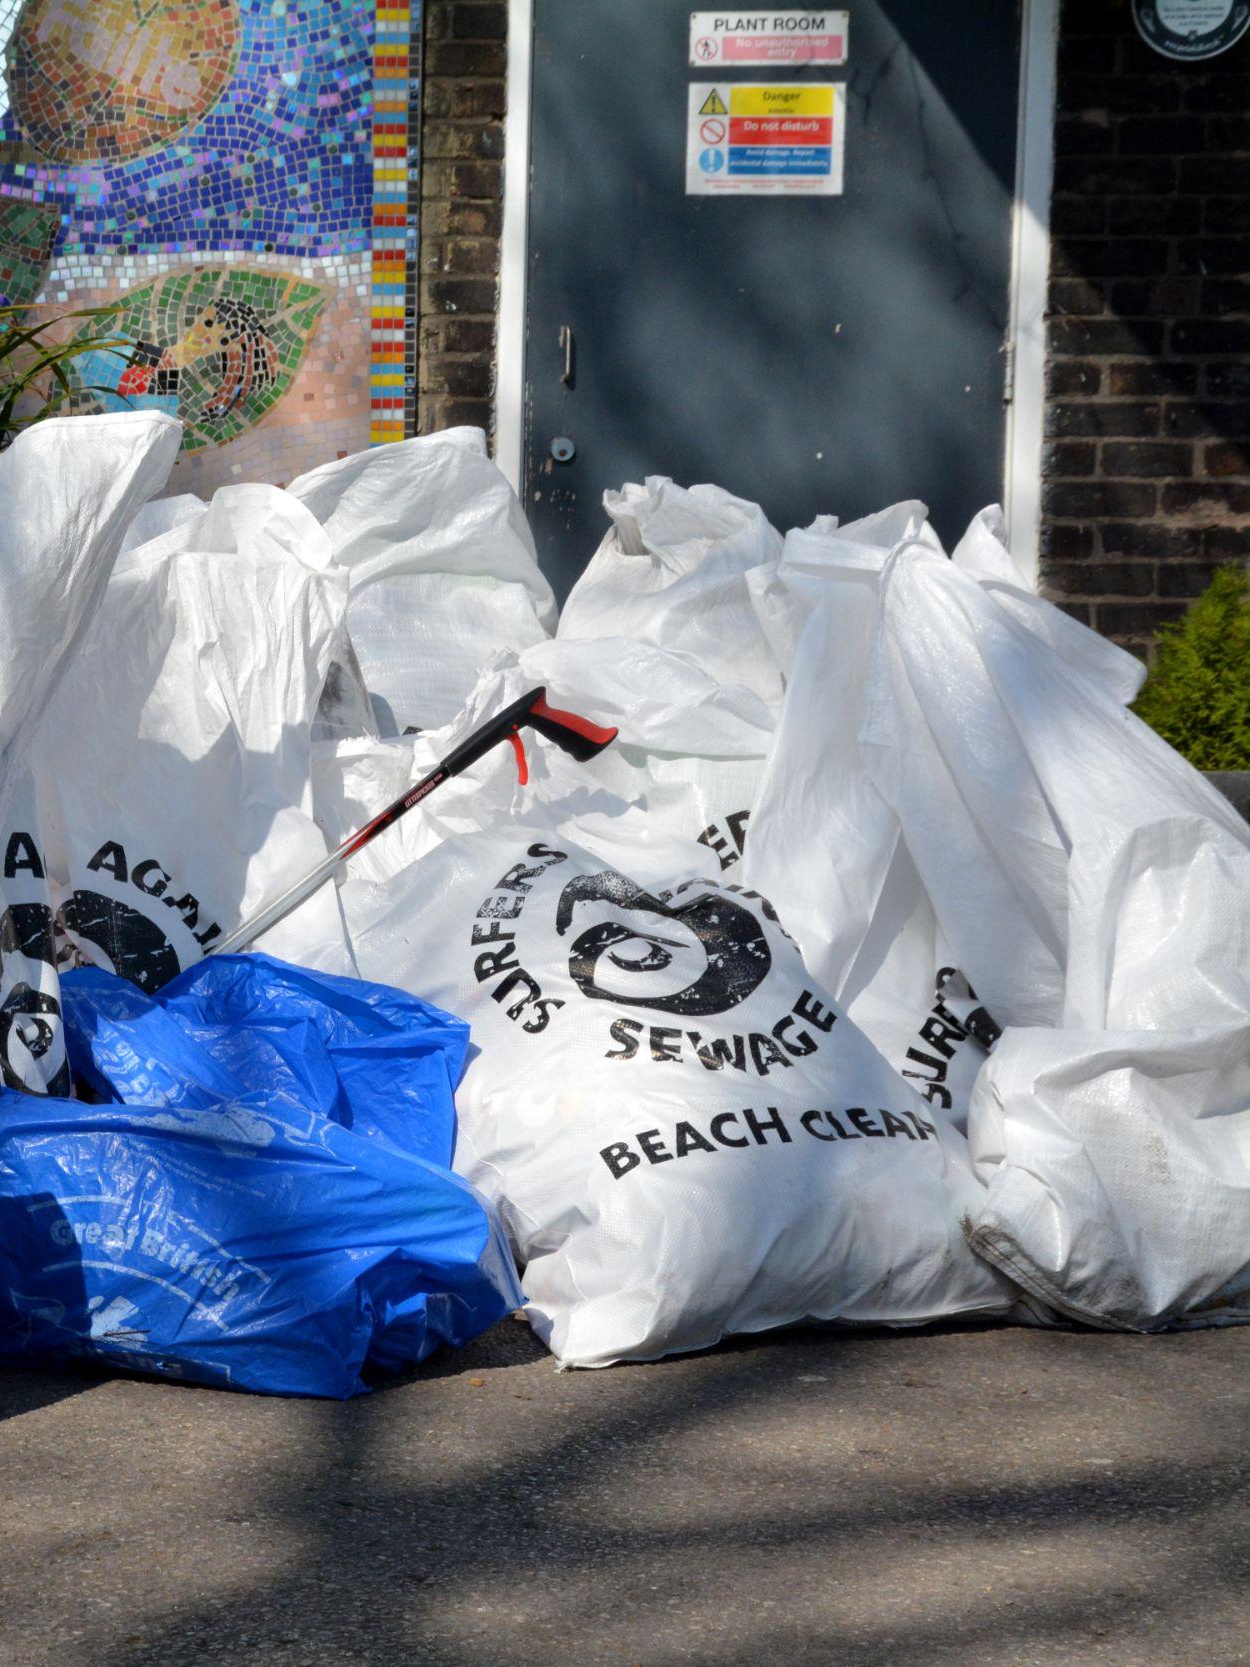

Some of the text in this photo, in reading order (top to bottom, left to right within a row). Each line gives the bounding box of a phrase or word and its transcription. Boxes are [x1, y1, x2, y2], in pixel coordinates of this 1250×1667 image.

[714, 17, 825, 31] PLANT ROOM
[736, 37, 750, 48] No
[767, 48, 797, 58] entry
[763, 91, 801, 102] Danger
[743, 120, 820, 131] Do not disturb
[470, 842, 569, 1034] SURFERS
[604, 990, 838, 1077] SEWAGE
[599, 1106, 793, 1180] BEACH
